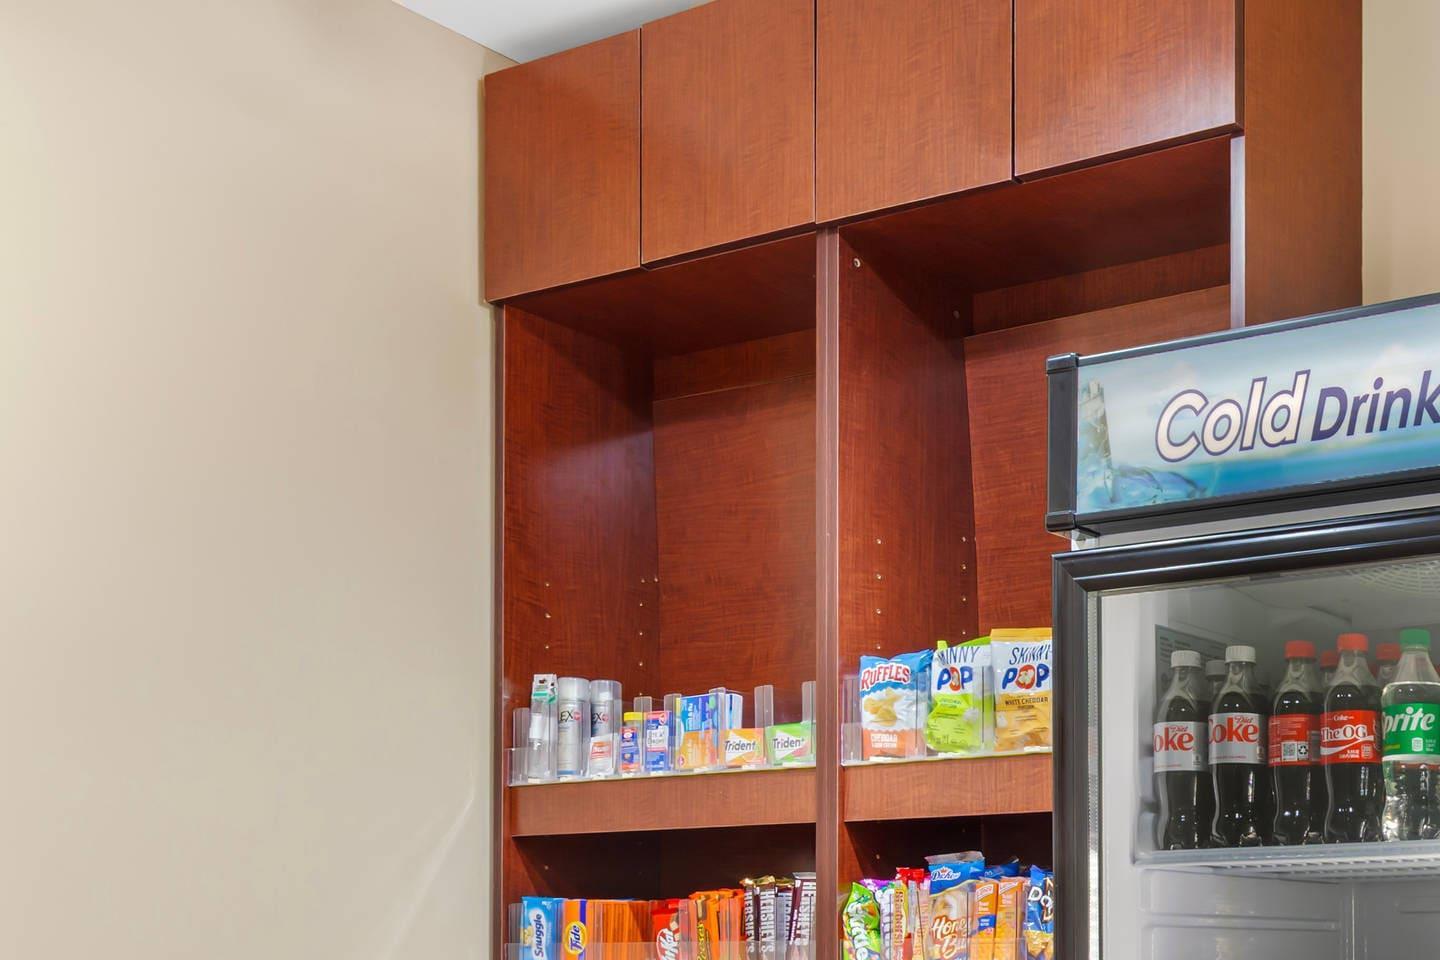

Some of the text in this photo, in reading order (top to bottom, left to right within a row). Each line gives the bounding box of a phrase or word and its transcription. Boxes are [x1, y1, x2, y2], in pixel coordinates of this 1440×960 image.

[1155, 369, 1311, 463] Cold
[861, 663, 911, 691] RUFFLES
[937, 666, 973, 691] POP
[1002, 664, 1050, 690] POP
[1342, 724, 1368, 739] OG
[1382, 706, 1435, 739] prite
[724, 739, 756, 751] Trident
[773, 737, 805, 749] Trident
[1154, 727, 1194, 752] oke
[535, 914, 544, 957] Snuggle
[570, 925, 582, 951] Tide
